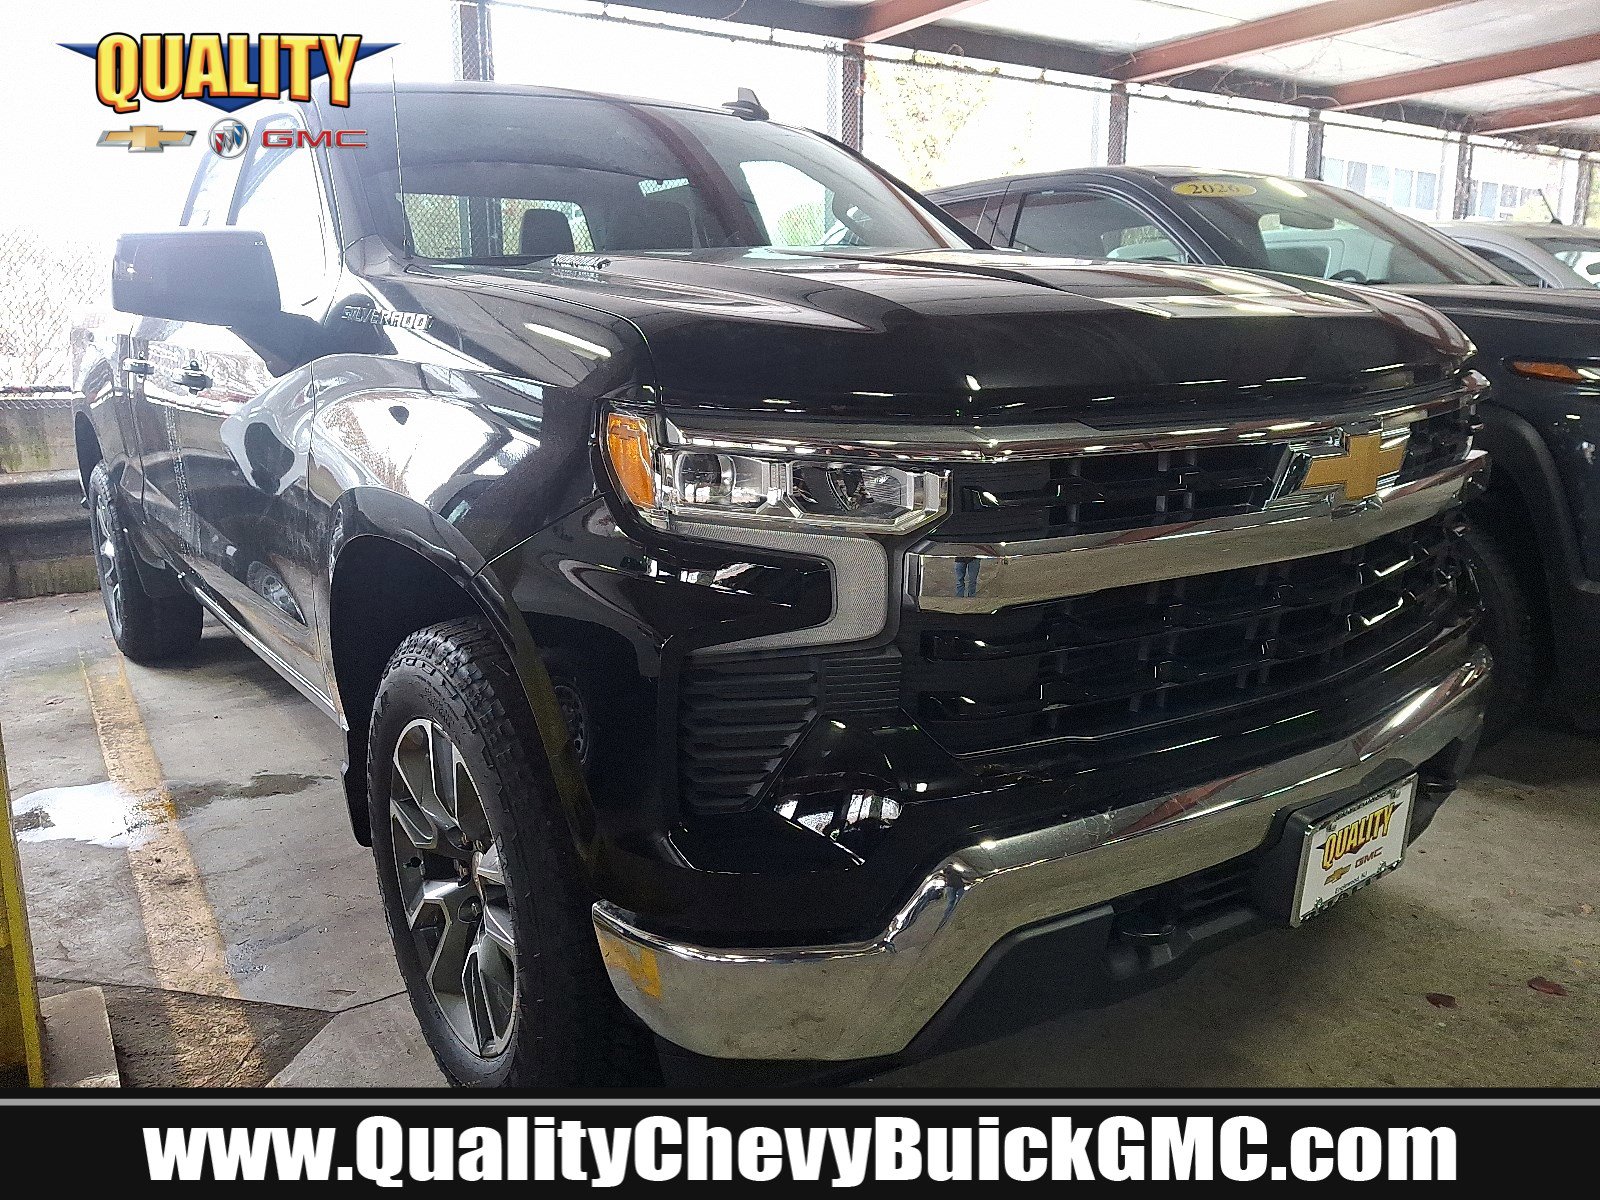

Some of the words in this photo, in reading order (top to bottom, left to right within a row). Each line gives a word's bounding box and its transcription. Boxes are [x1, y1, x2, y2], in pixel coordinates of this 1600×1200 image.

[341, 305, 434, 331] SILVERADO
[1321, 802, 1395, 871] QUALITY
[1355, 847, 1383, 868] GMC
